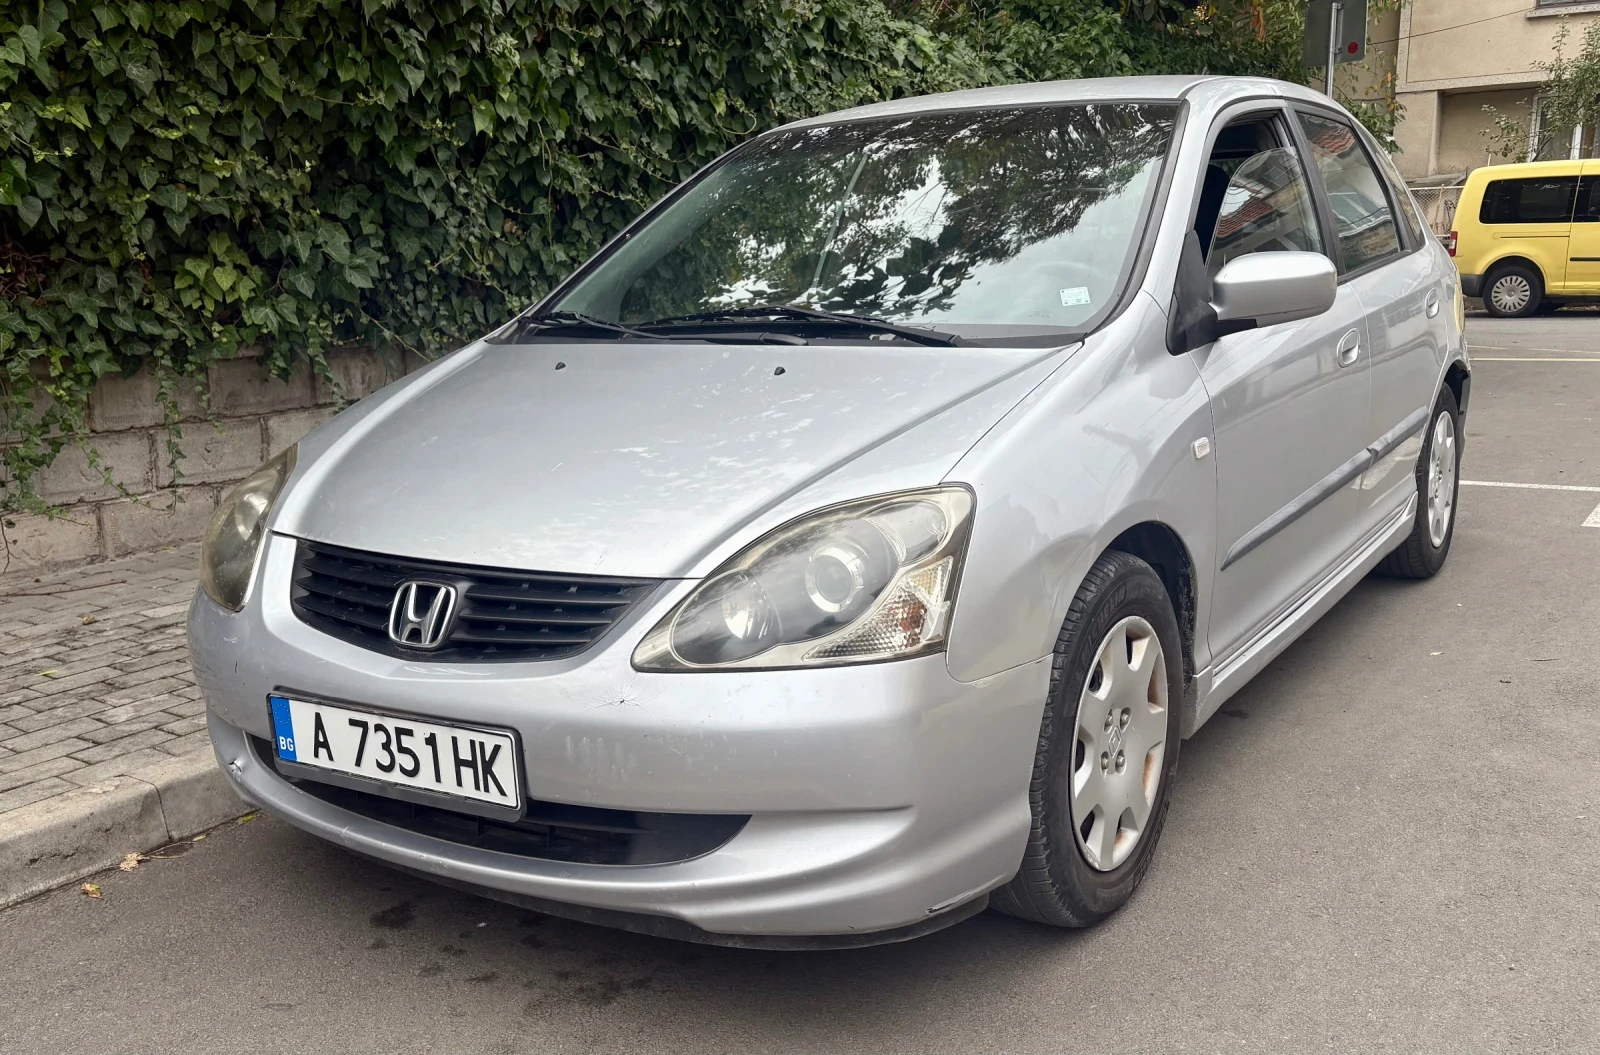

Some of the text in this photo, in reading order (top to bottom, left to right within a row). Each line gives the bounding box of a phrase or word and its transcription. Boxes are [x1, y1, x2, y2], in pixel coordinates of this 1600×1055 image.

[279, 736, 294, 752] BG
[314, 711, 508, 798] A 7351 HK
